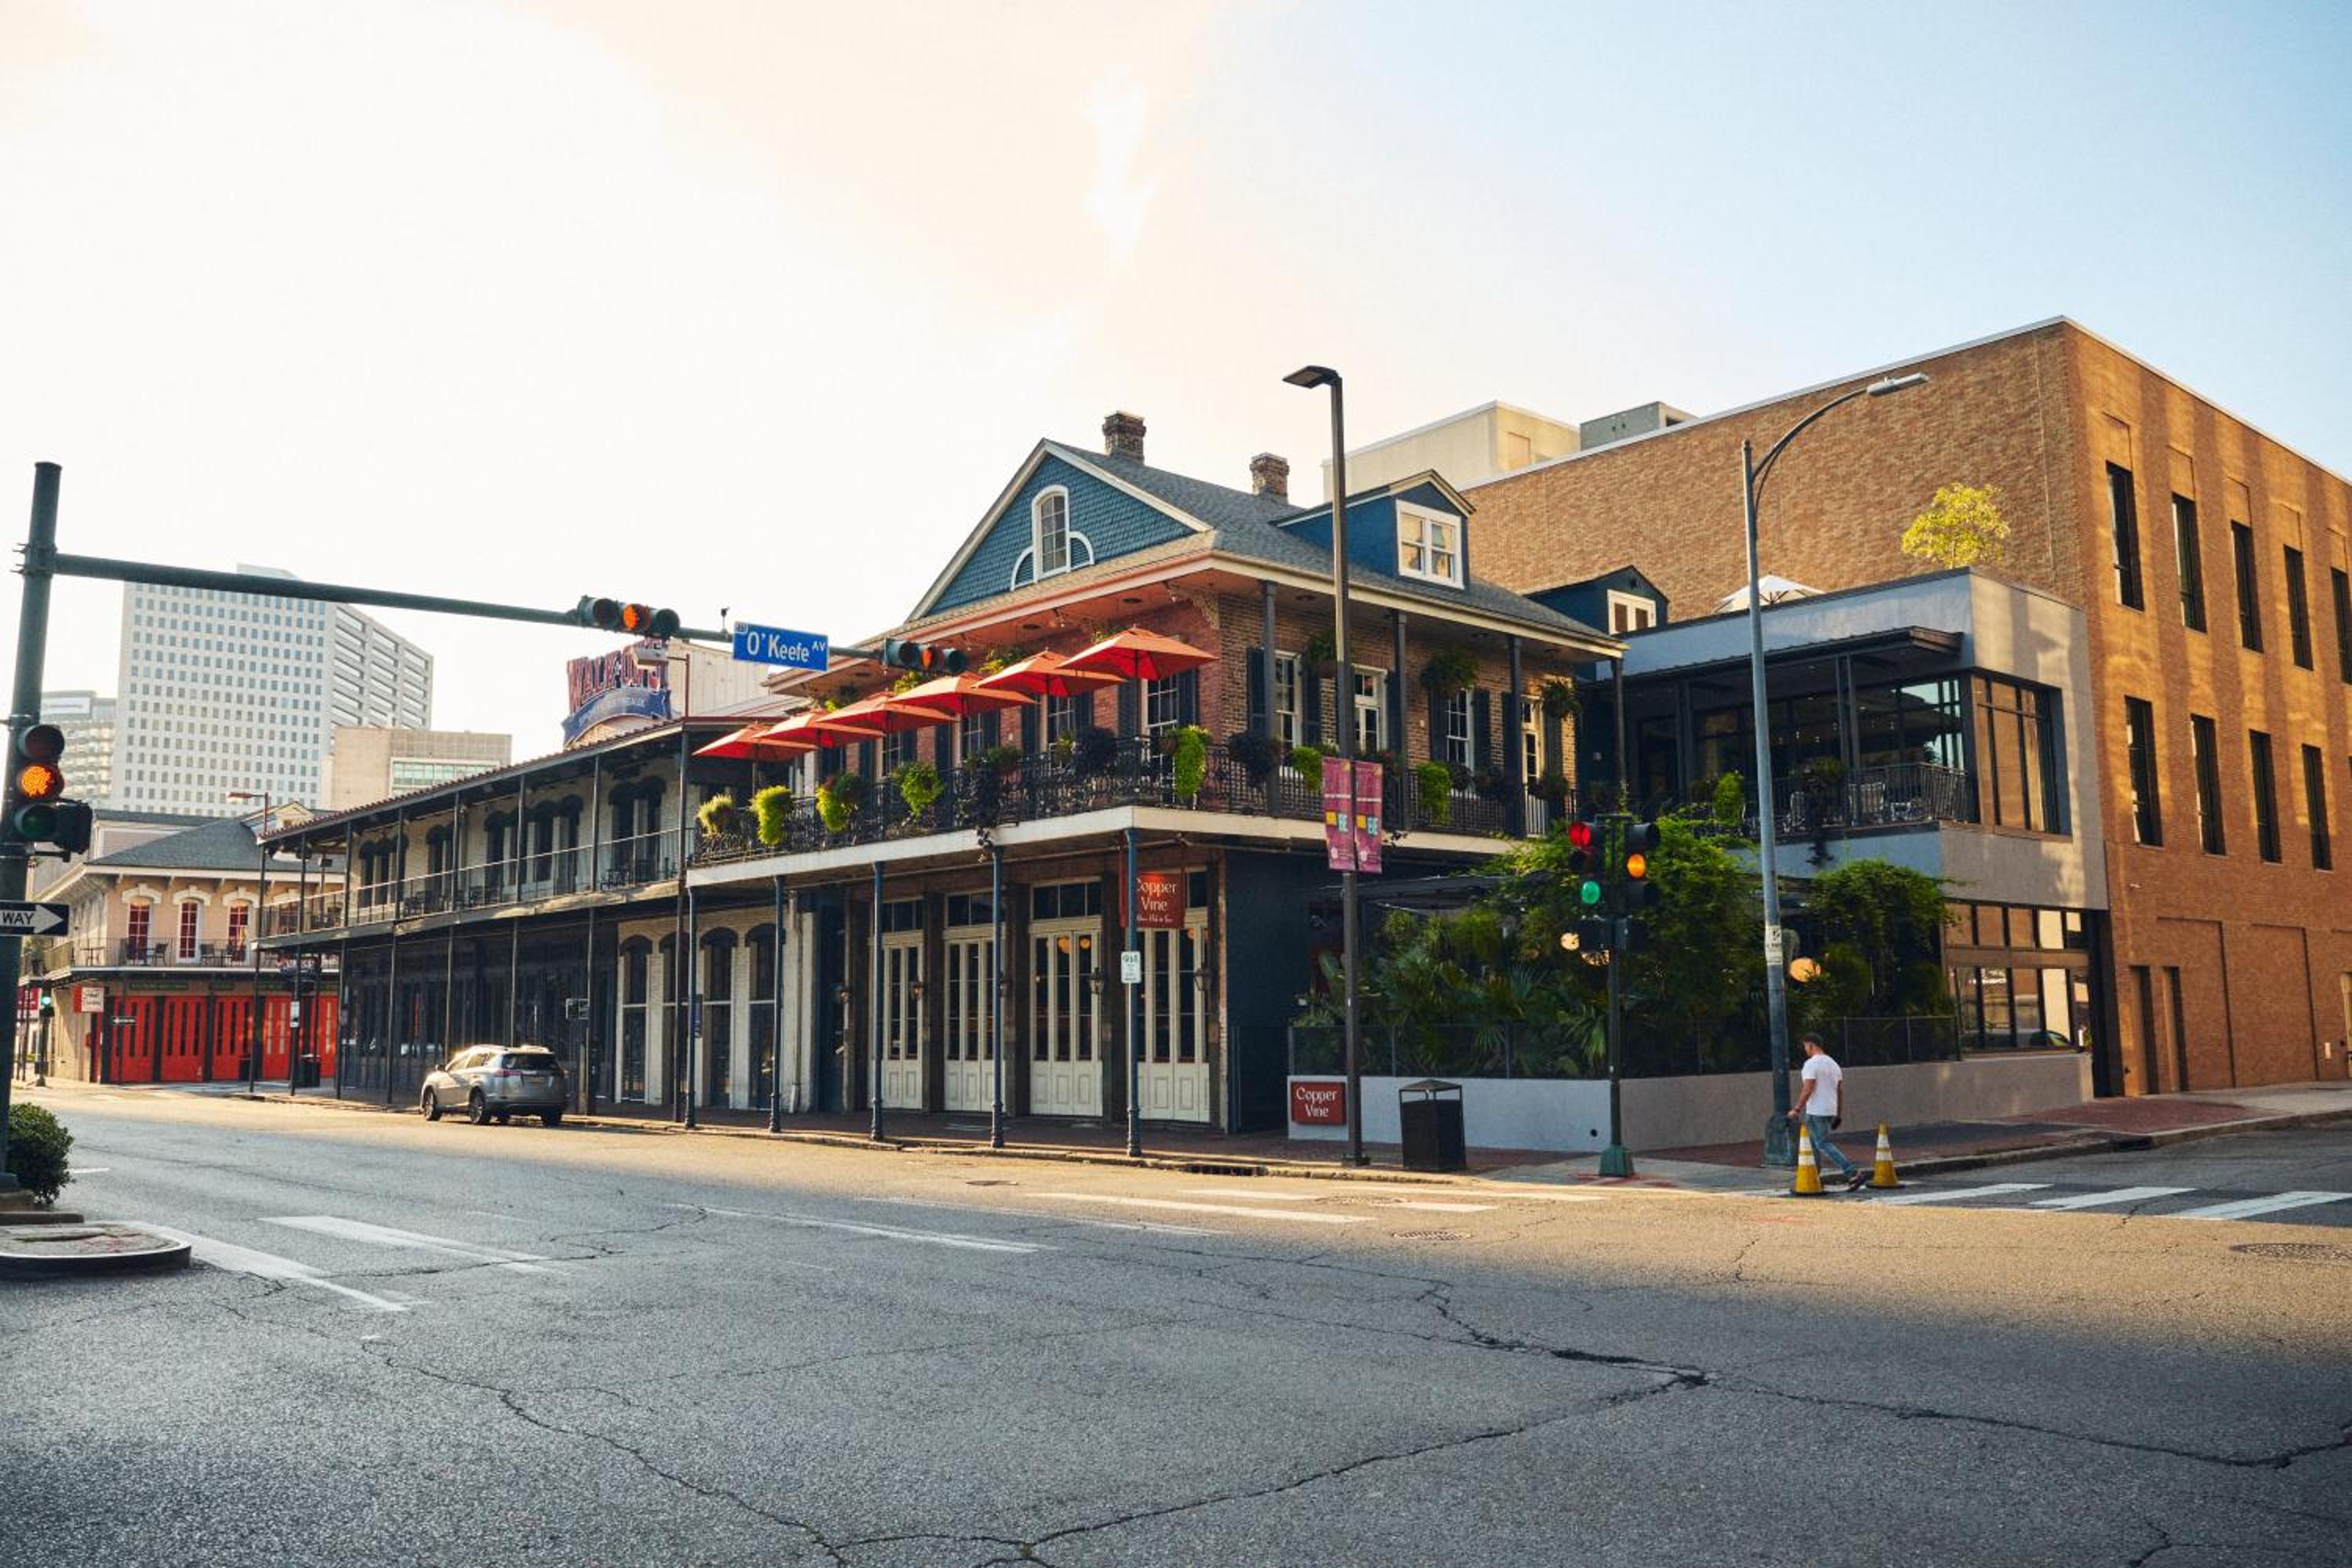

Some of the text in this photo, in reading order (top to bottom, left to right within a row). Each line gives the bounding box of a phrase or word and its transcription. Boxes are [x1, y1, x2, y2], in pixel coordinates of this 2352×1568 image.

[747, 631, 810, 662] O'Keefe
[2, 911, 34, 924] WAY
[1296, 1086, 1338, 1105] Copper
[1305, 1104, 1329, 1117] Vine
